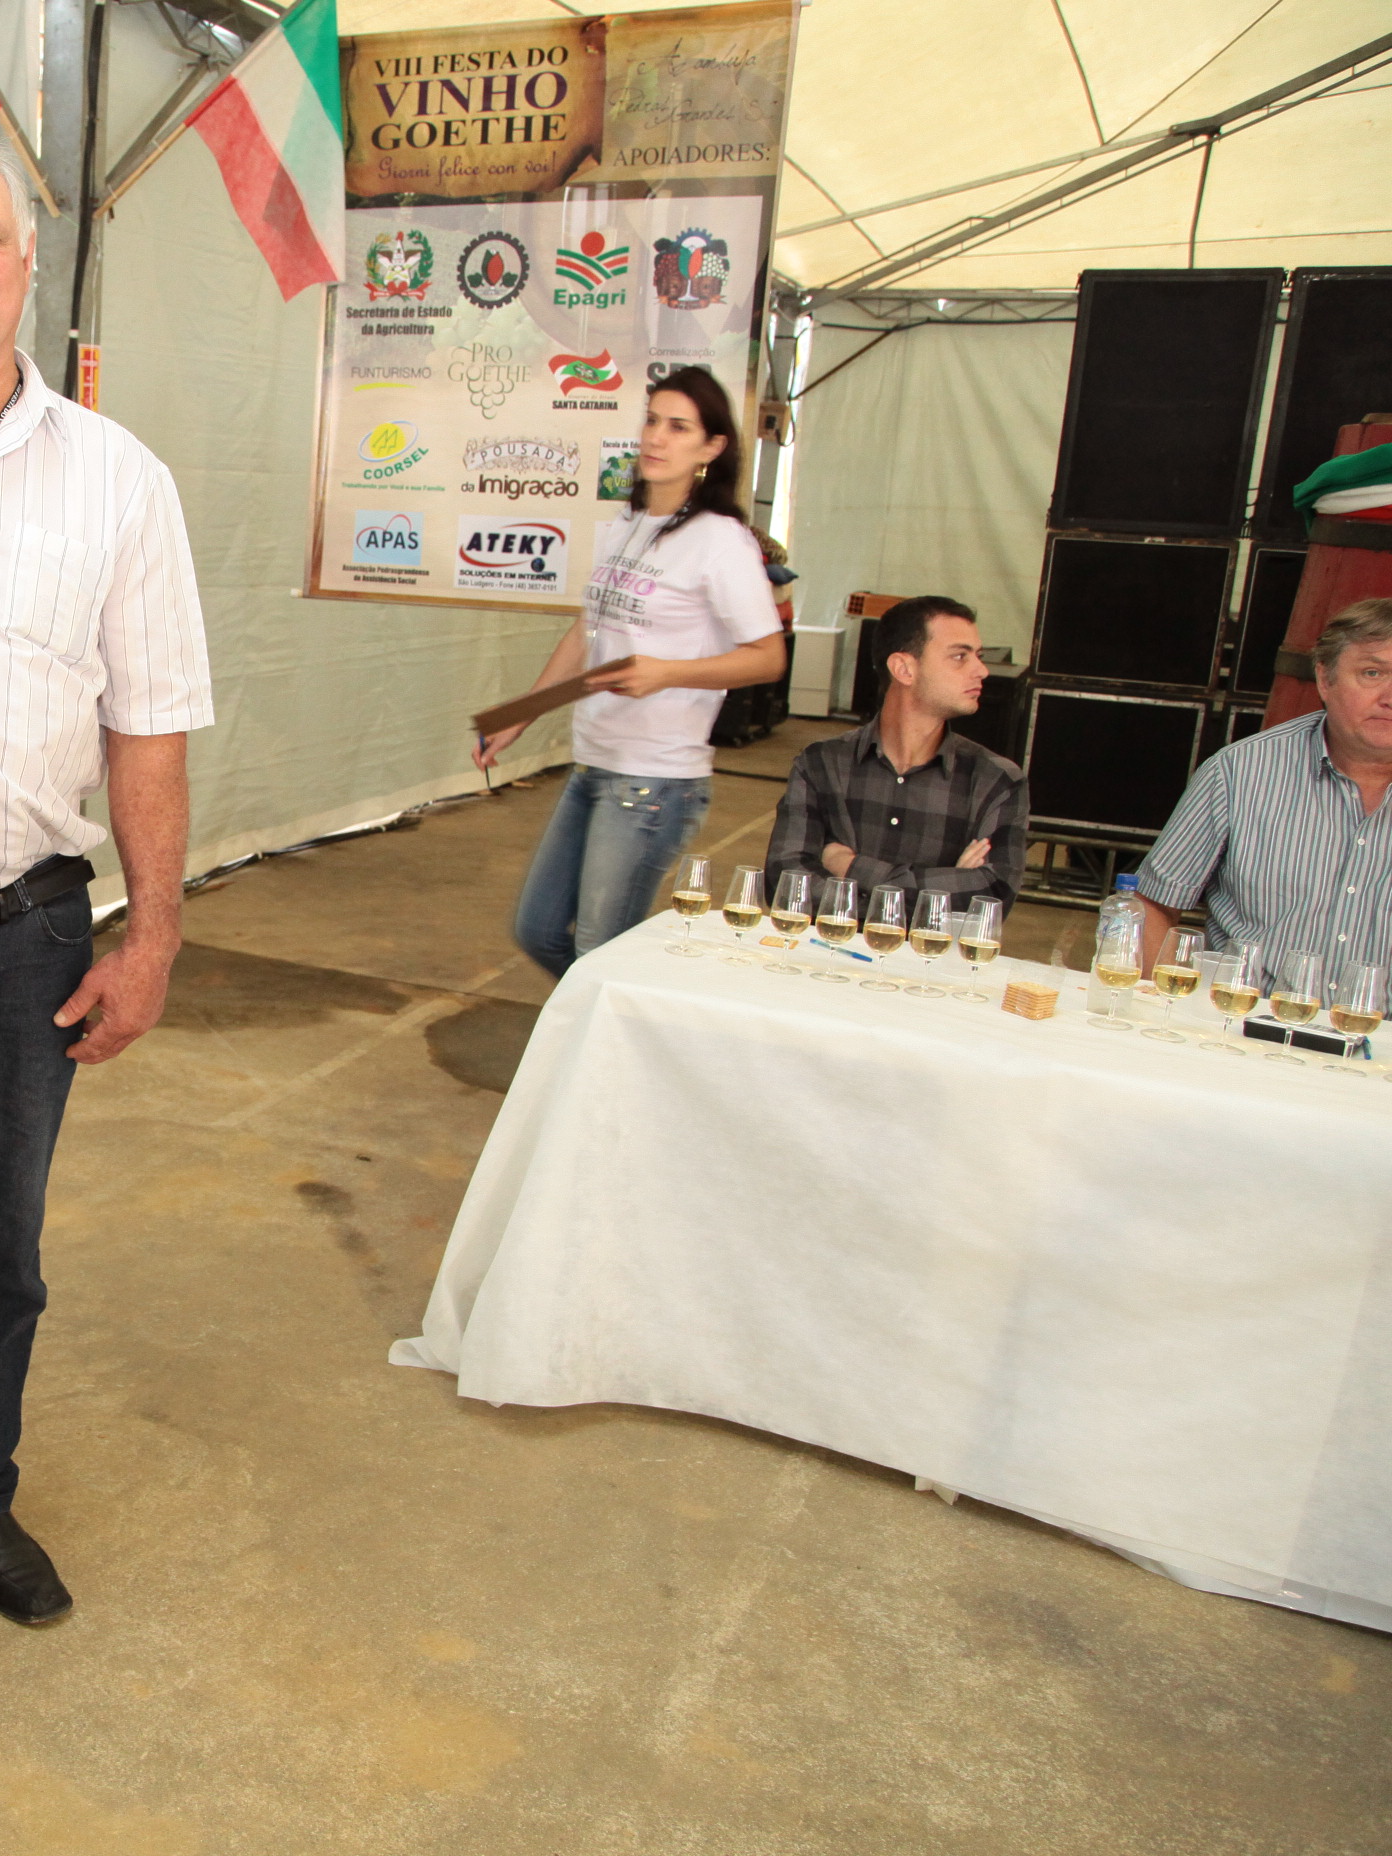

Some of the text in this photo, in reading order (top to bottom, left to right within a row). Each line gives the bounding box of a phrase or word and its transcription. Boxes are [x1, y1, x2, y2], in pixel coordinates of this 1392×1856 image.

[375, 46, 569, 78] VIII FESTA DO
[373, 71, 568, 119] VINHO
[371, 113, 567, 151] GOETHE
[613, 142, 770, 167] APOIADORES:
[378, 151, 557, 186] Giorni felice con voi!
[553, 288, 626, 309] Epagri
[346, 305, 453, 319] Secretaria de Estado
[361, 323, 435, 337] da Agricultura
[471, 342, 513, 363] PRO
[649, 346, 715, 359] Correalização
[350, 366, 432, 380] FUNTURISMO
[447, 361, 531, 383] GOETHE
[552, 400, 619, 411] SANTA CATARINA
[363, 447, 429, 480] COORSEL
[480, 443, 566, 467] POUSADA
[461, 474, 579, 500] da Imigração
[365, 530, 419, 550] APAS
[466, 532, 556, 555] ATEKY
[459, 568, 502, 580] SOLUÇÕES
[518, 573, 557, 582] INTERNET
